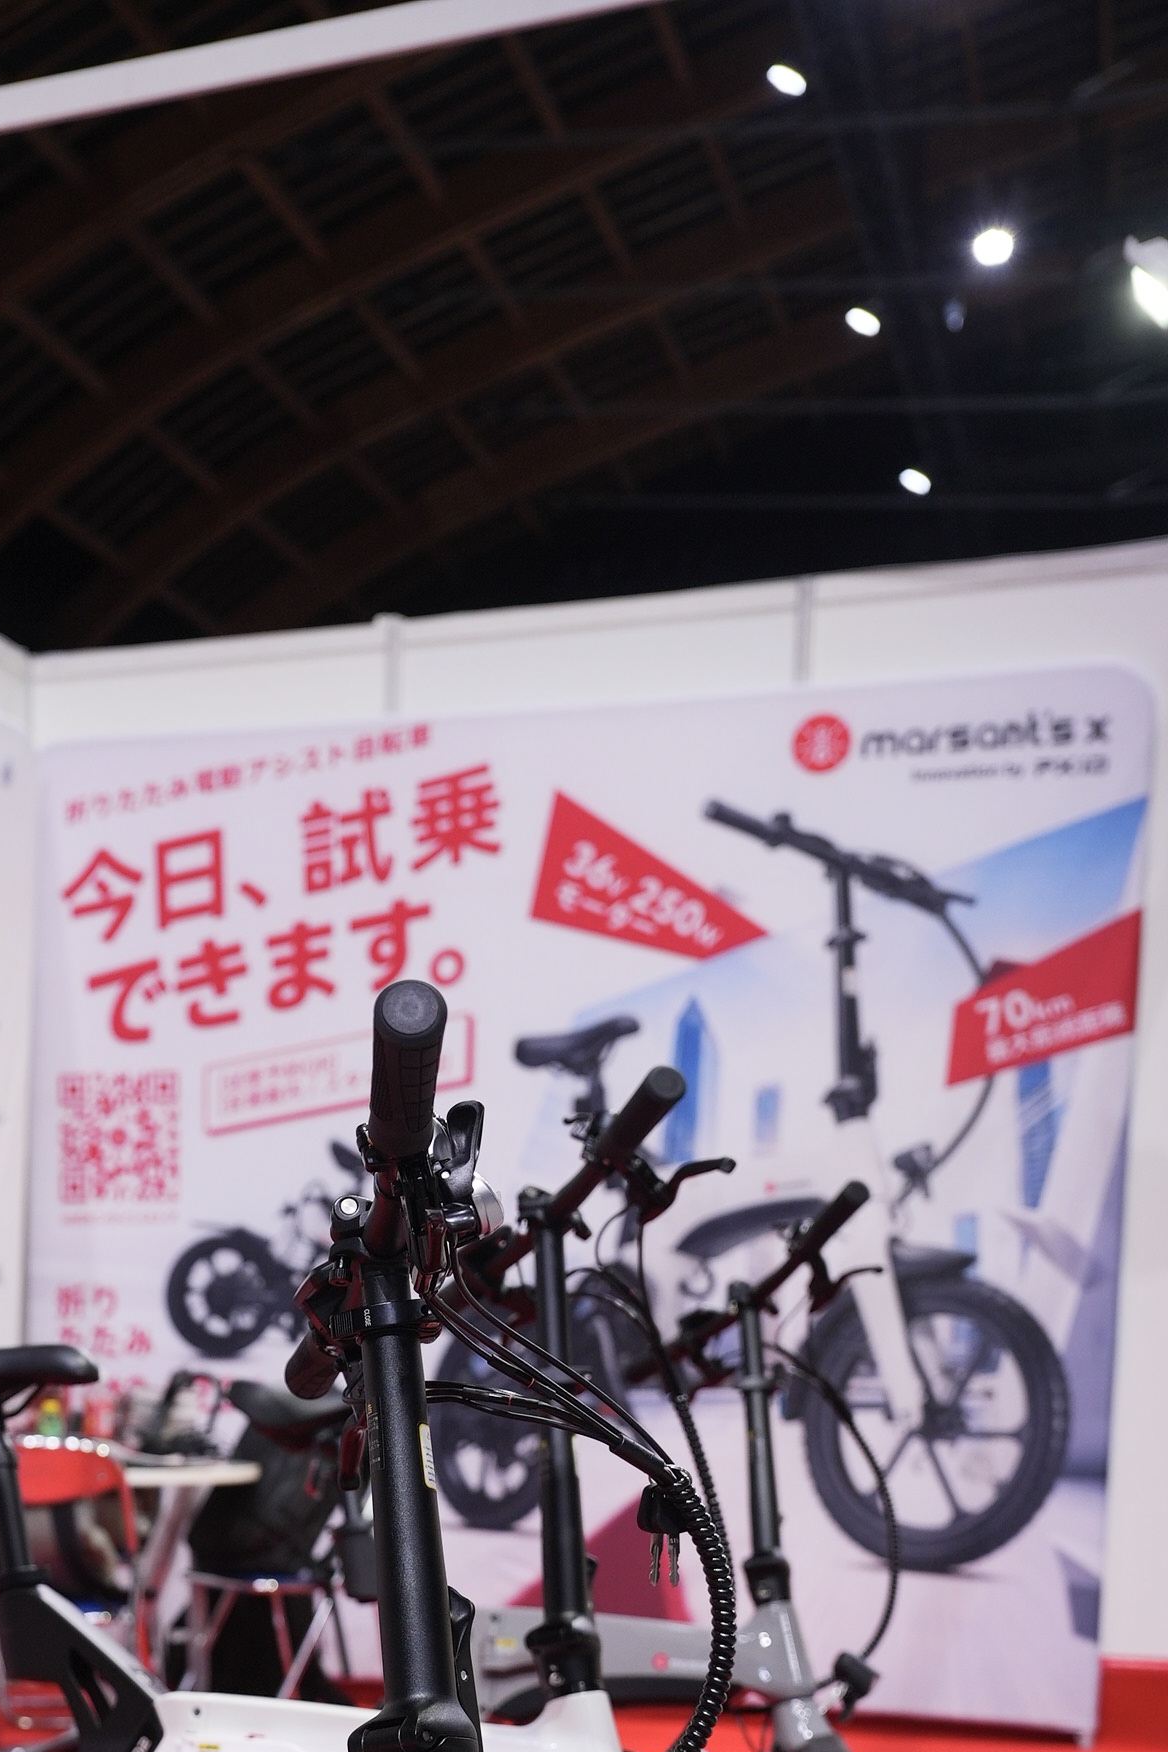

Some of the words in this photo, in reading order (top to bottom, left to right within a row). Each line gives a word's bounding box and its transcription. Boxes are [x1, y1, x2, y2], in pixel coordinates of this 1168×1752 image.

[554, 878, 659, 936] モーター
[88, 900, 466, 1042] できます。
